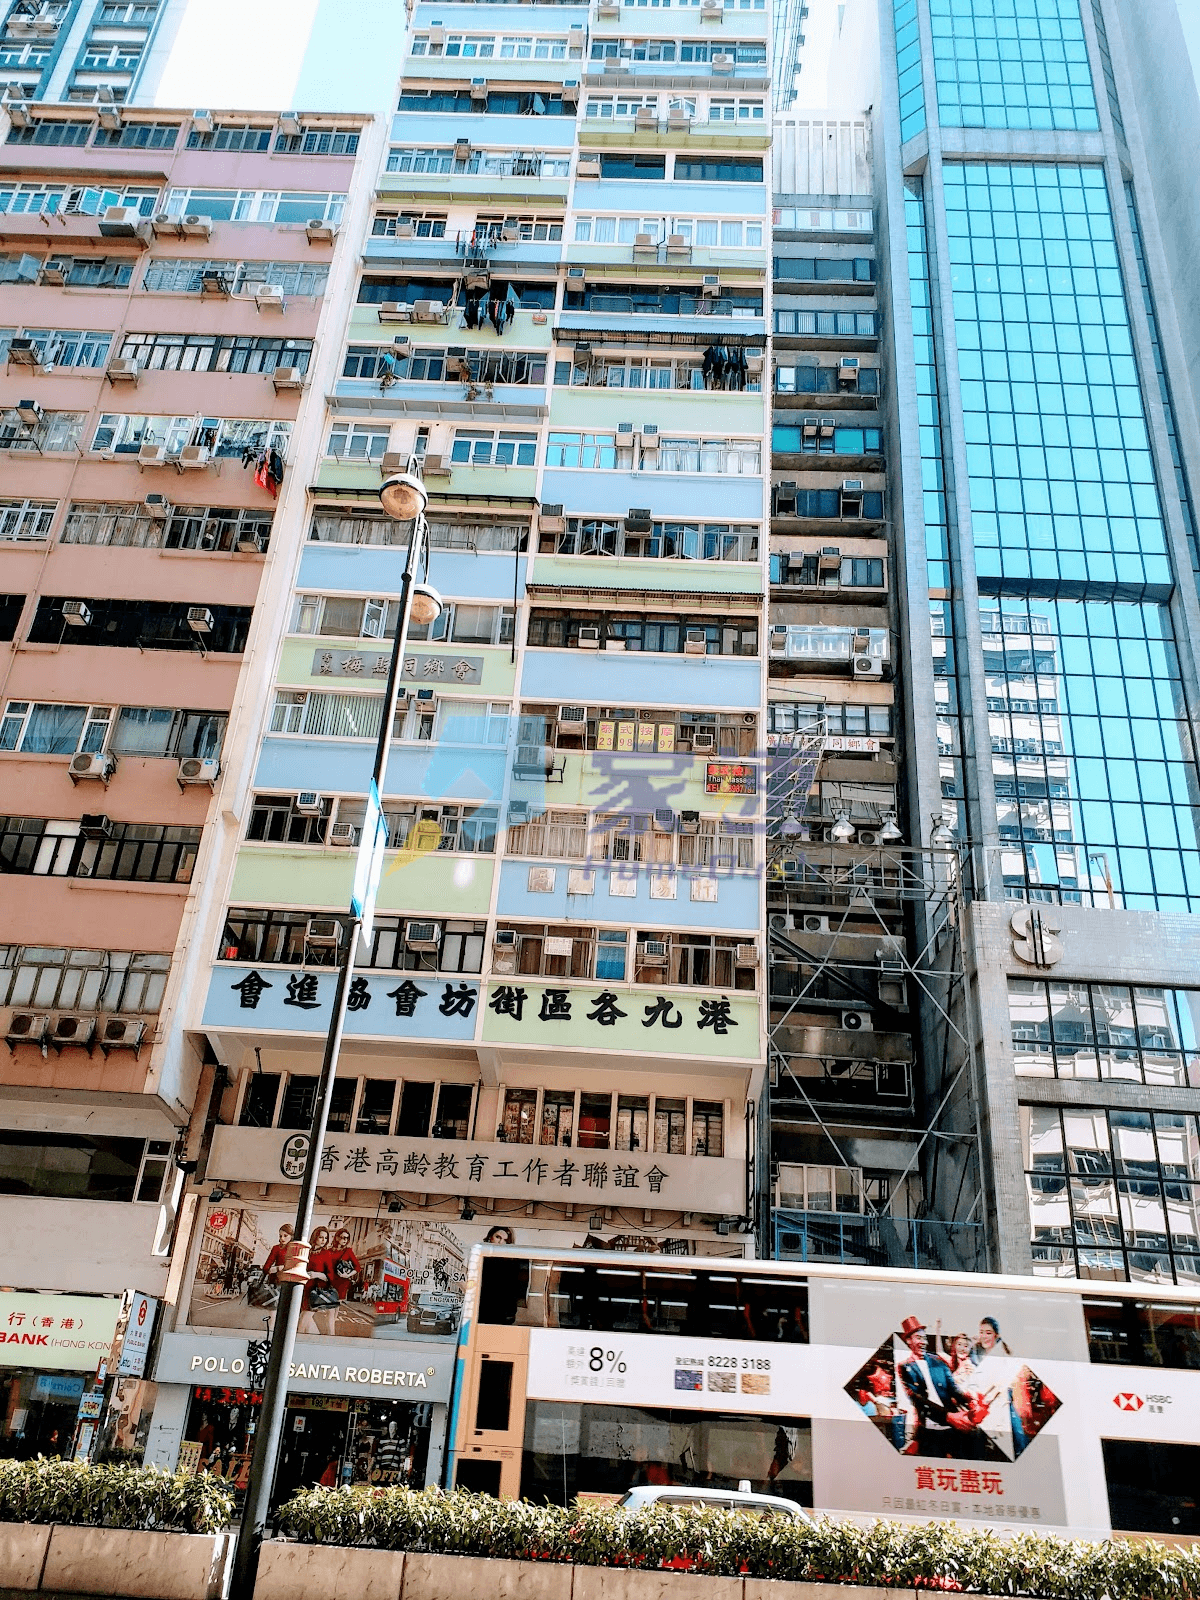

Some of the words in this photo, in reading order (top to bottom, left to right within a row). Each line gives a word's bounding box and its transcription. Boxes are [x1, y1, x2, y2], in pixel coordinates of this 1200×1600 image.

[320, 1144, 670, 1194] 香港高齡教育工作者聯誼會
[399, 1268, 430, 1279] POLO
[87, 1340, 113, 1351] KON
[589, 1346, 627, 1373] 8%
[707, 1355, 738, 1369] 8228
[740, 1357, 771, 1371] 3188
[190, 1355, 245, 1374] POLO
[288, 1362, 342, 1382] SANTA
[345, 1366, 428, 1388] ROBERTA
[1145, 1394, 1173, 1404] HSBC
[914, 1465, 1004, 1496] 賞玩盡玩
